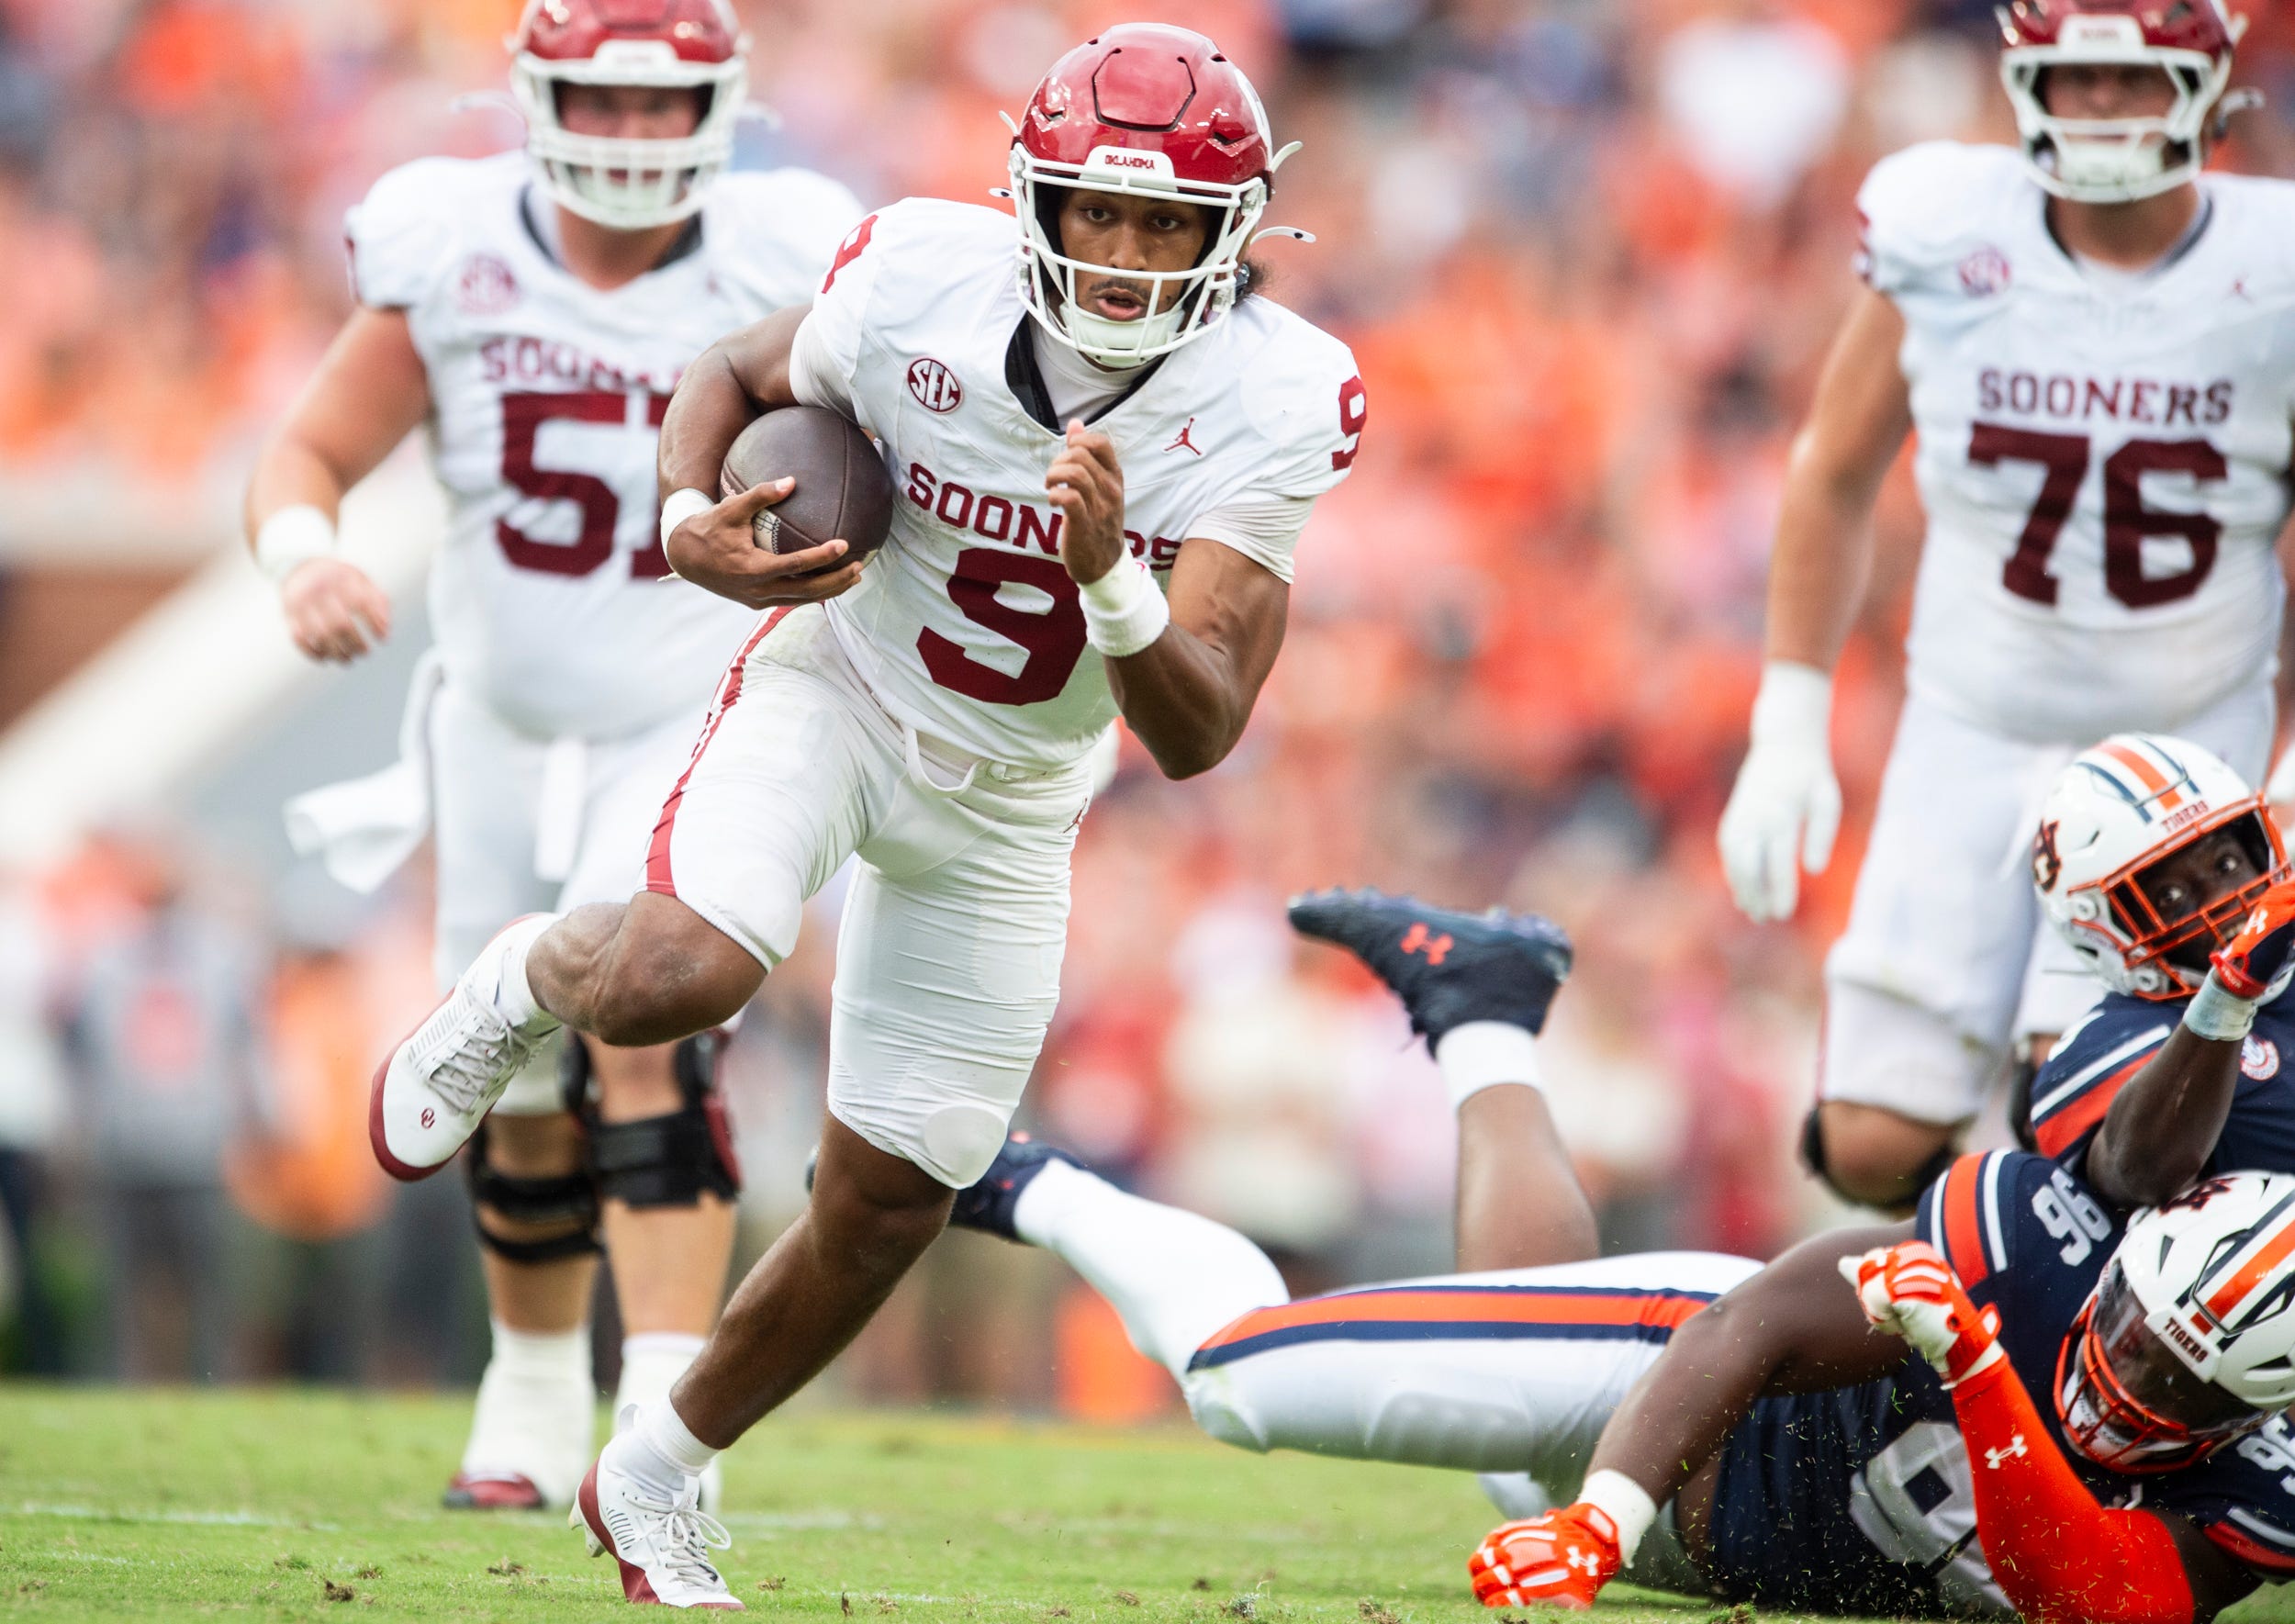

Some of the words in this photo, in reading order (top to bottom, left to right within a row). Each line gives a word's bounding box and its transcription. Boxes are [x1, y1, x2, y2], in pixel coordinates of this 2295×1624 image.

[1104, 154, 1155, 170] OKLAHOMA
[910, 359, 959, 411] SEC
[1977, 368, 2233, 425] SOONERS
[1331, 375, 1367, 472] 9
[1967, 420, 2228, 611] 76
[915, 546, 1089, 707] 9
[2160, 800, 2210, 832] TIGERS
[2032, 1167, 2111, 1267] 96
[2164, 1316, 2210, 1364] TIGERS
